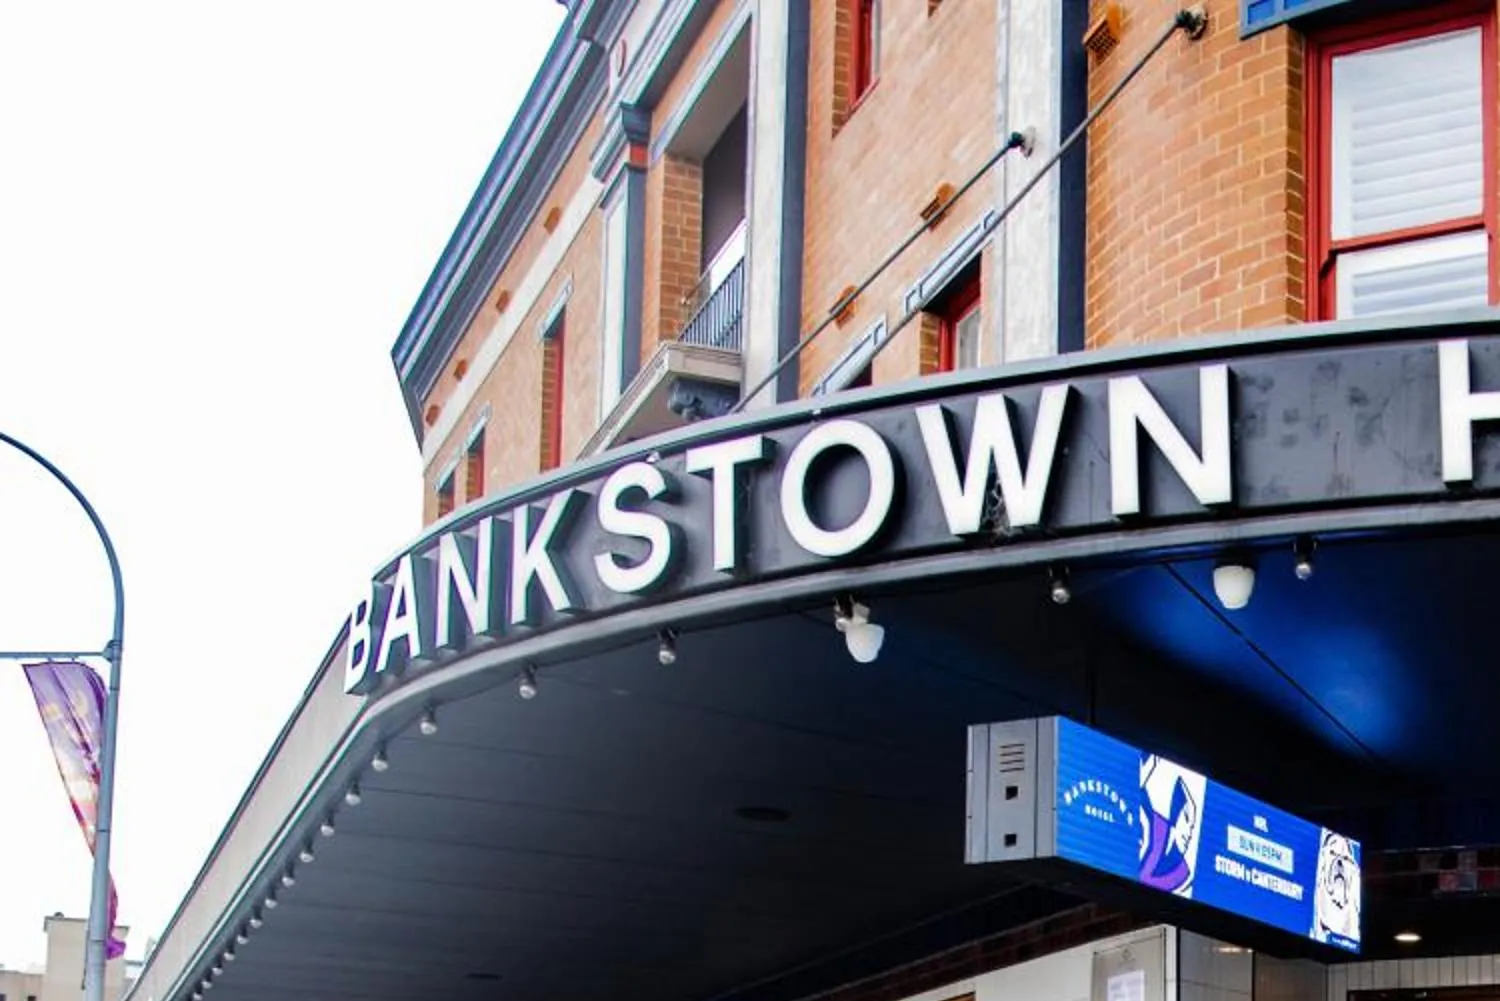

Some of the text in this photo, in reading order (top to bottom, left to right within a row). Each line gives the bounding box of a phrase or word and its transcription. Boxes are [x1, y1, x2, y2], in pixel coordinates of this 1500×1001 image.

[344, 364, 1236, 694] BANKSTOWN
[1063, 779, 1134, 826] BANKSTOWN
[1084, 803, 1115, 823] HOTEL
